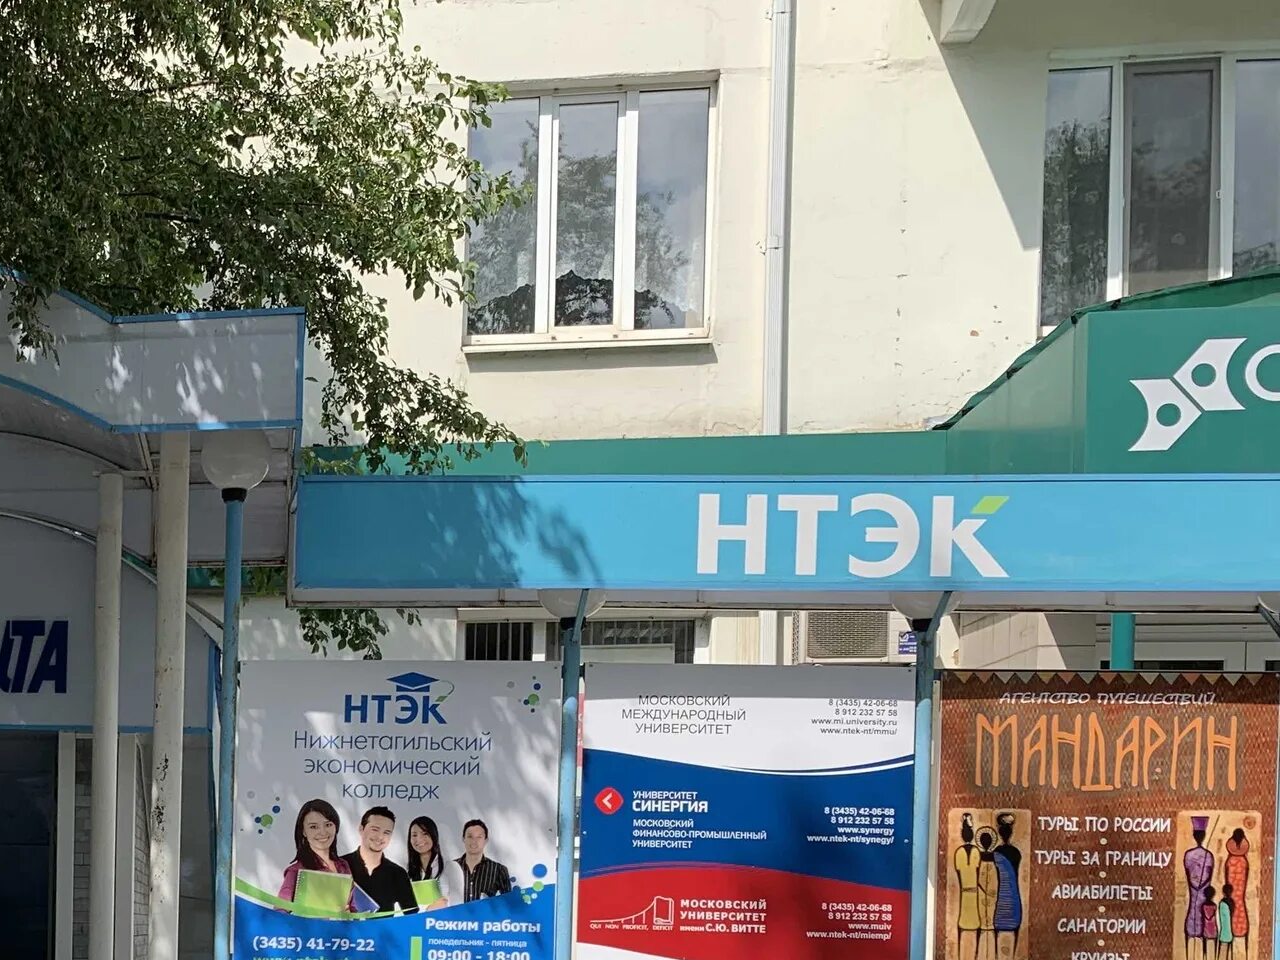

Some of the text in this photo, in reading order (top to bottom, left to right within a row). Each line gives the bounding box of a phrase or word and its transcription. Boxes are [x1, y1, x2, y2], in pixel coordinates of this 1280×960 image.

[638, 694, 731, 706] МОСКОВСКИЙ
[836, 699, 861, 708] (3435)
[863, 699, 898, 707] 42-06-68
[1000, 692, 1216, 705] АГЕНТСТВО ПУТЕШЕСТВИЙ
[622, 708, 746, 722] МЕЖДУНАРОДНЫЙ
[635, 723, 732, 735] УНИВЕРСИТЕТ
[293, 730, 492, 752] Нижнетагильский
[975, 711, 1238, 791] МАНДАРИН
[304, 756, 481, 776] экономический
[342, 782, 440, 802] колледж
[633, 790, 698, 800] УНИВЕРСИТЕТ
[632, 800, 708, 813] СИНЕРГИЯ
[633, 818, 694, 828] МОСКОВСКИЙ
[1038, 816, 1171, 833] ТУРЫ ПО РОССИИ
[633, 829, 767, 840] ФИНАНСОВО-ПРОМЫШЛЕННЫЙ
[838, 826, 894, 836] www.synergy
[632, 839, 692, 849] УНИВЕРСИТЕТ
[1034, 850, 1172, 868] ТУРЫ ЗА ГРАНИЦУ
[1051, 884, 1153, 901] АВИАБИЛЕТЫ
[680, 899, 767, 909] МОСКОВСКИЙ
[680, 910, 767, 922] УНИВЕРСИТЕТ
[426, 918, 540, 934] Режим работы
[706, 924, 730, 933] С.Ю.
[731, 924, 766, 933] ВИТТЕ
[1057, 918, 1146, 934] САНАТОРИИ
[252, 936, 375, 952] (3435) 41-79-22
[428, 938, 527, 948] понедельник пятница
